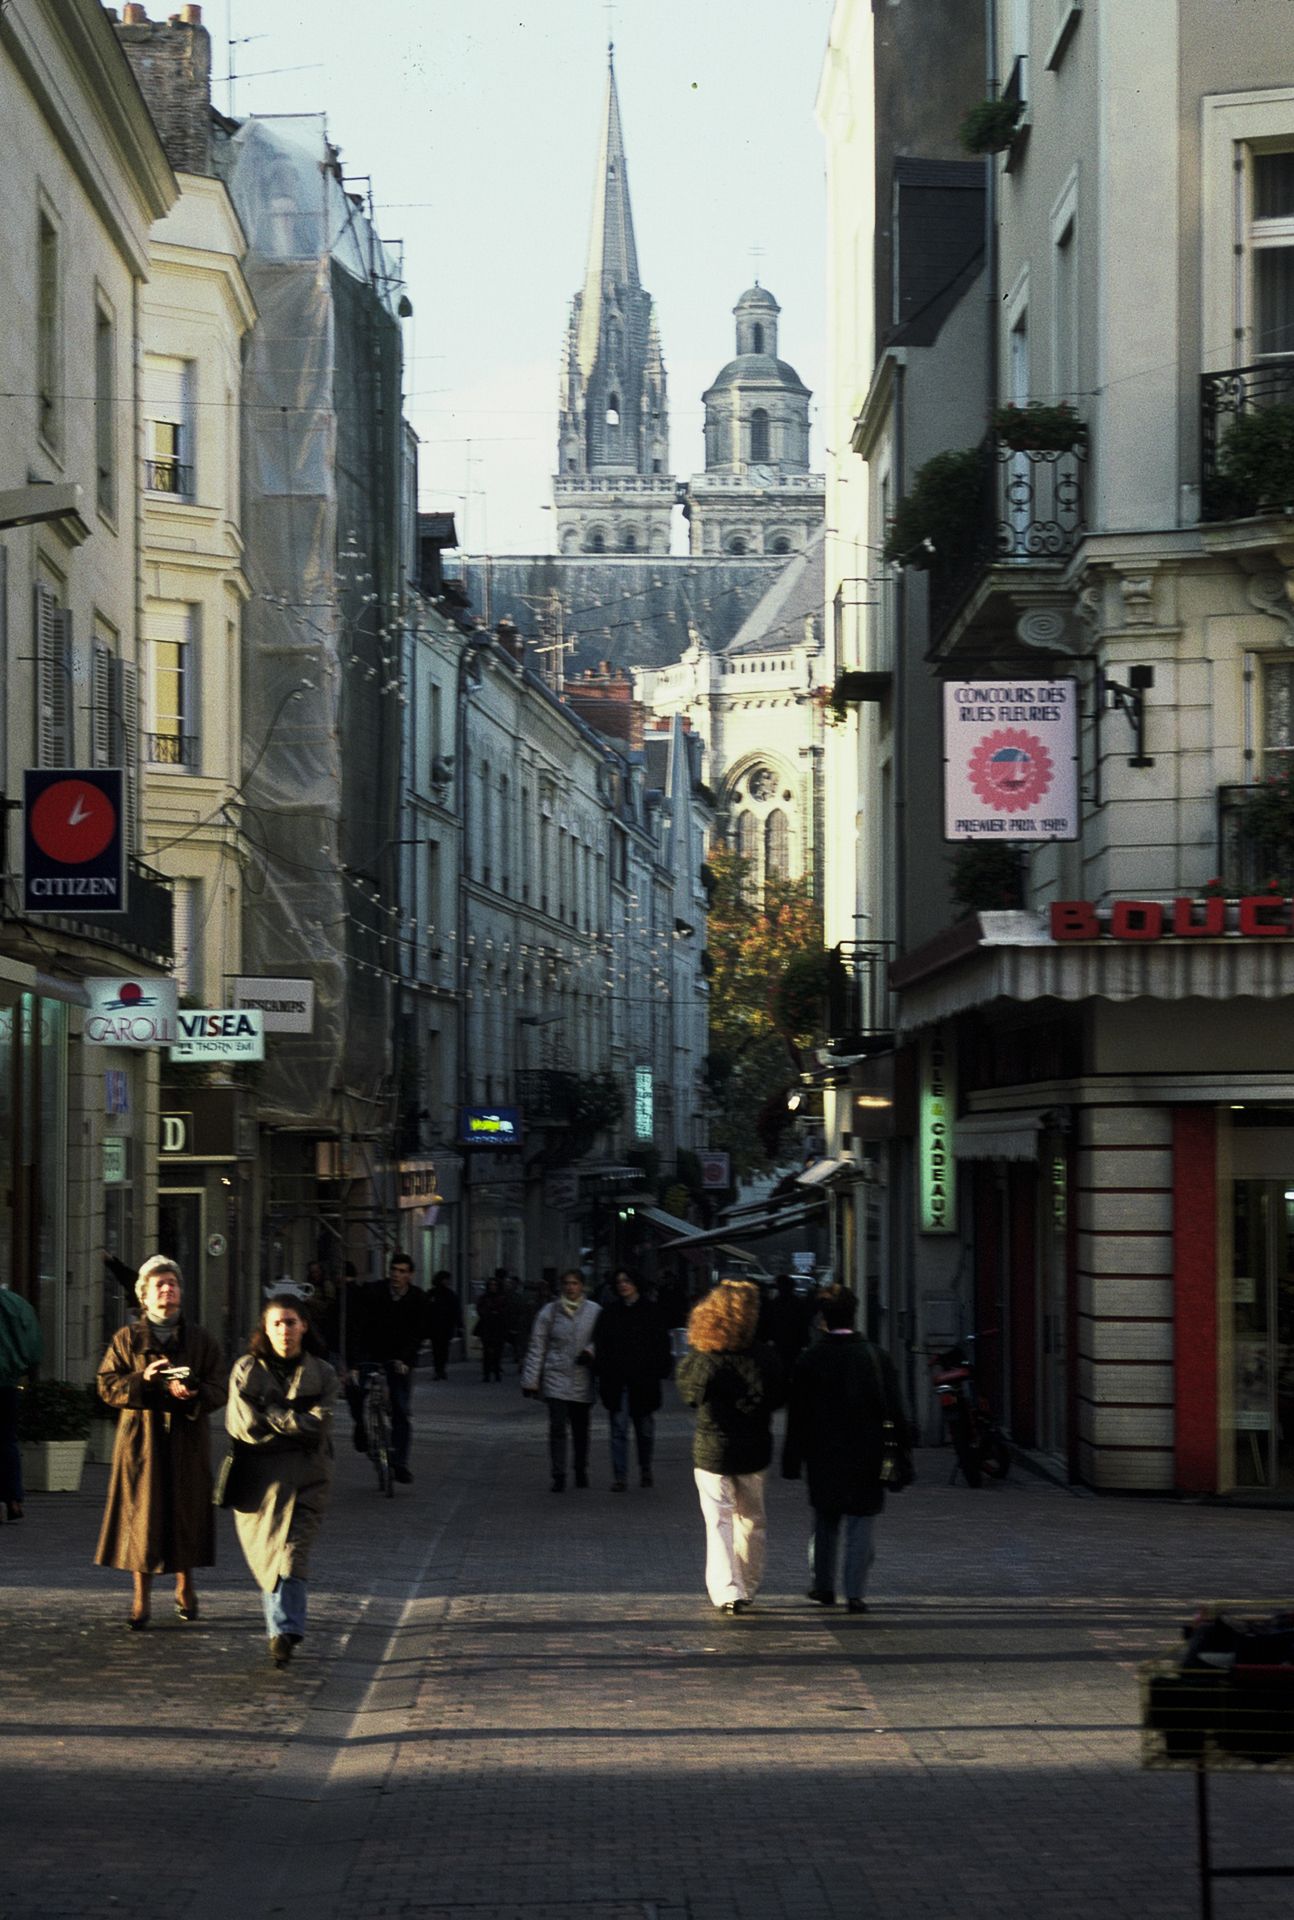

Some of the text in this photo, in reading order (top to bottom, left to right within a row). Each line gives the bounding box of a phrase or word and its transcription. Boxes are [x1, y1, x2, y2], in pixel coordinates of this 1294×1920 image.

[955, 687, 1066, 704] CONCOURS DES
[958, 706, 1061, 722] RUES FLEURIES
[955, 819, 1006, 833] PREMIER
[1009, 819, 1038, 832] PRIX
[29, 877, 118, 896] CITIZEN
[1051, 897, 1294, 941] BOUC
[86, 1016, 175, 1042] CAROLL
[931, 1123, 946, 1227] CADEAUX
